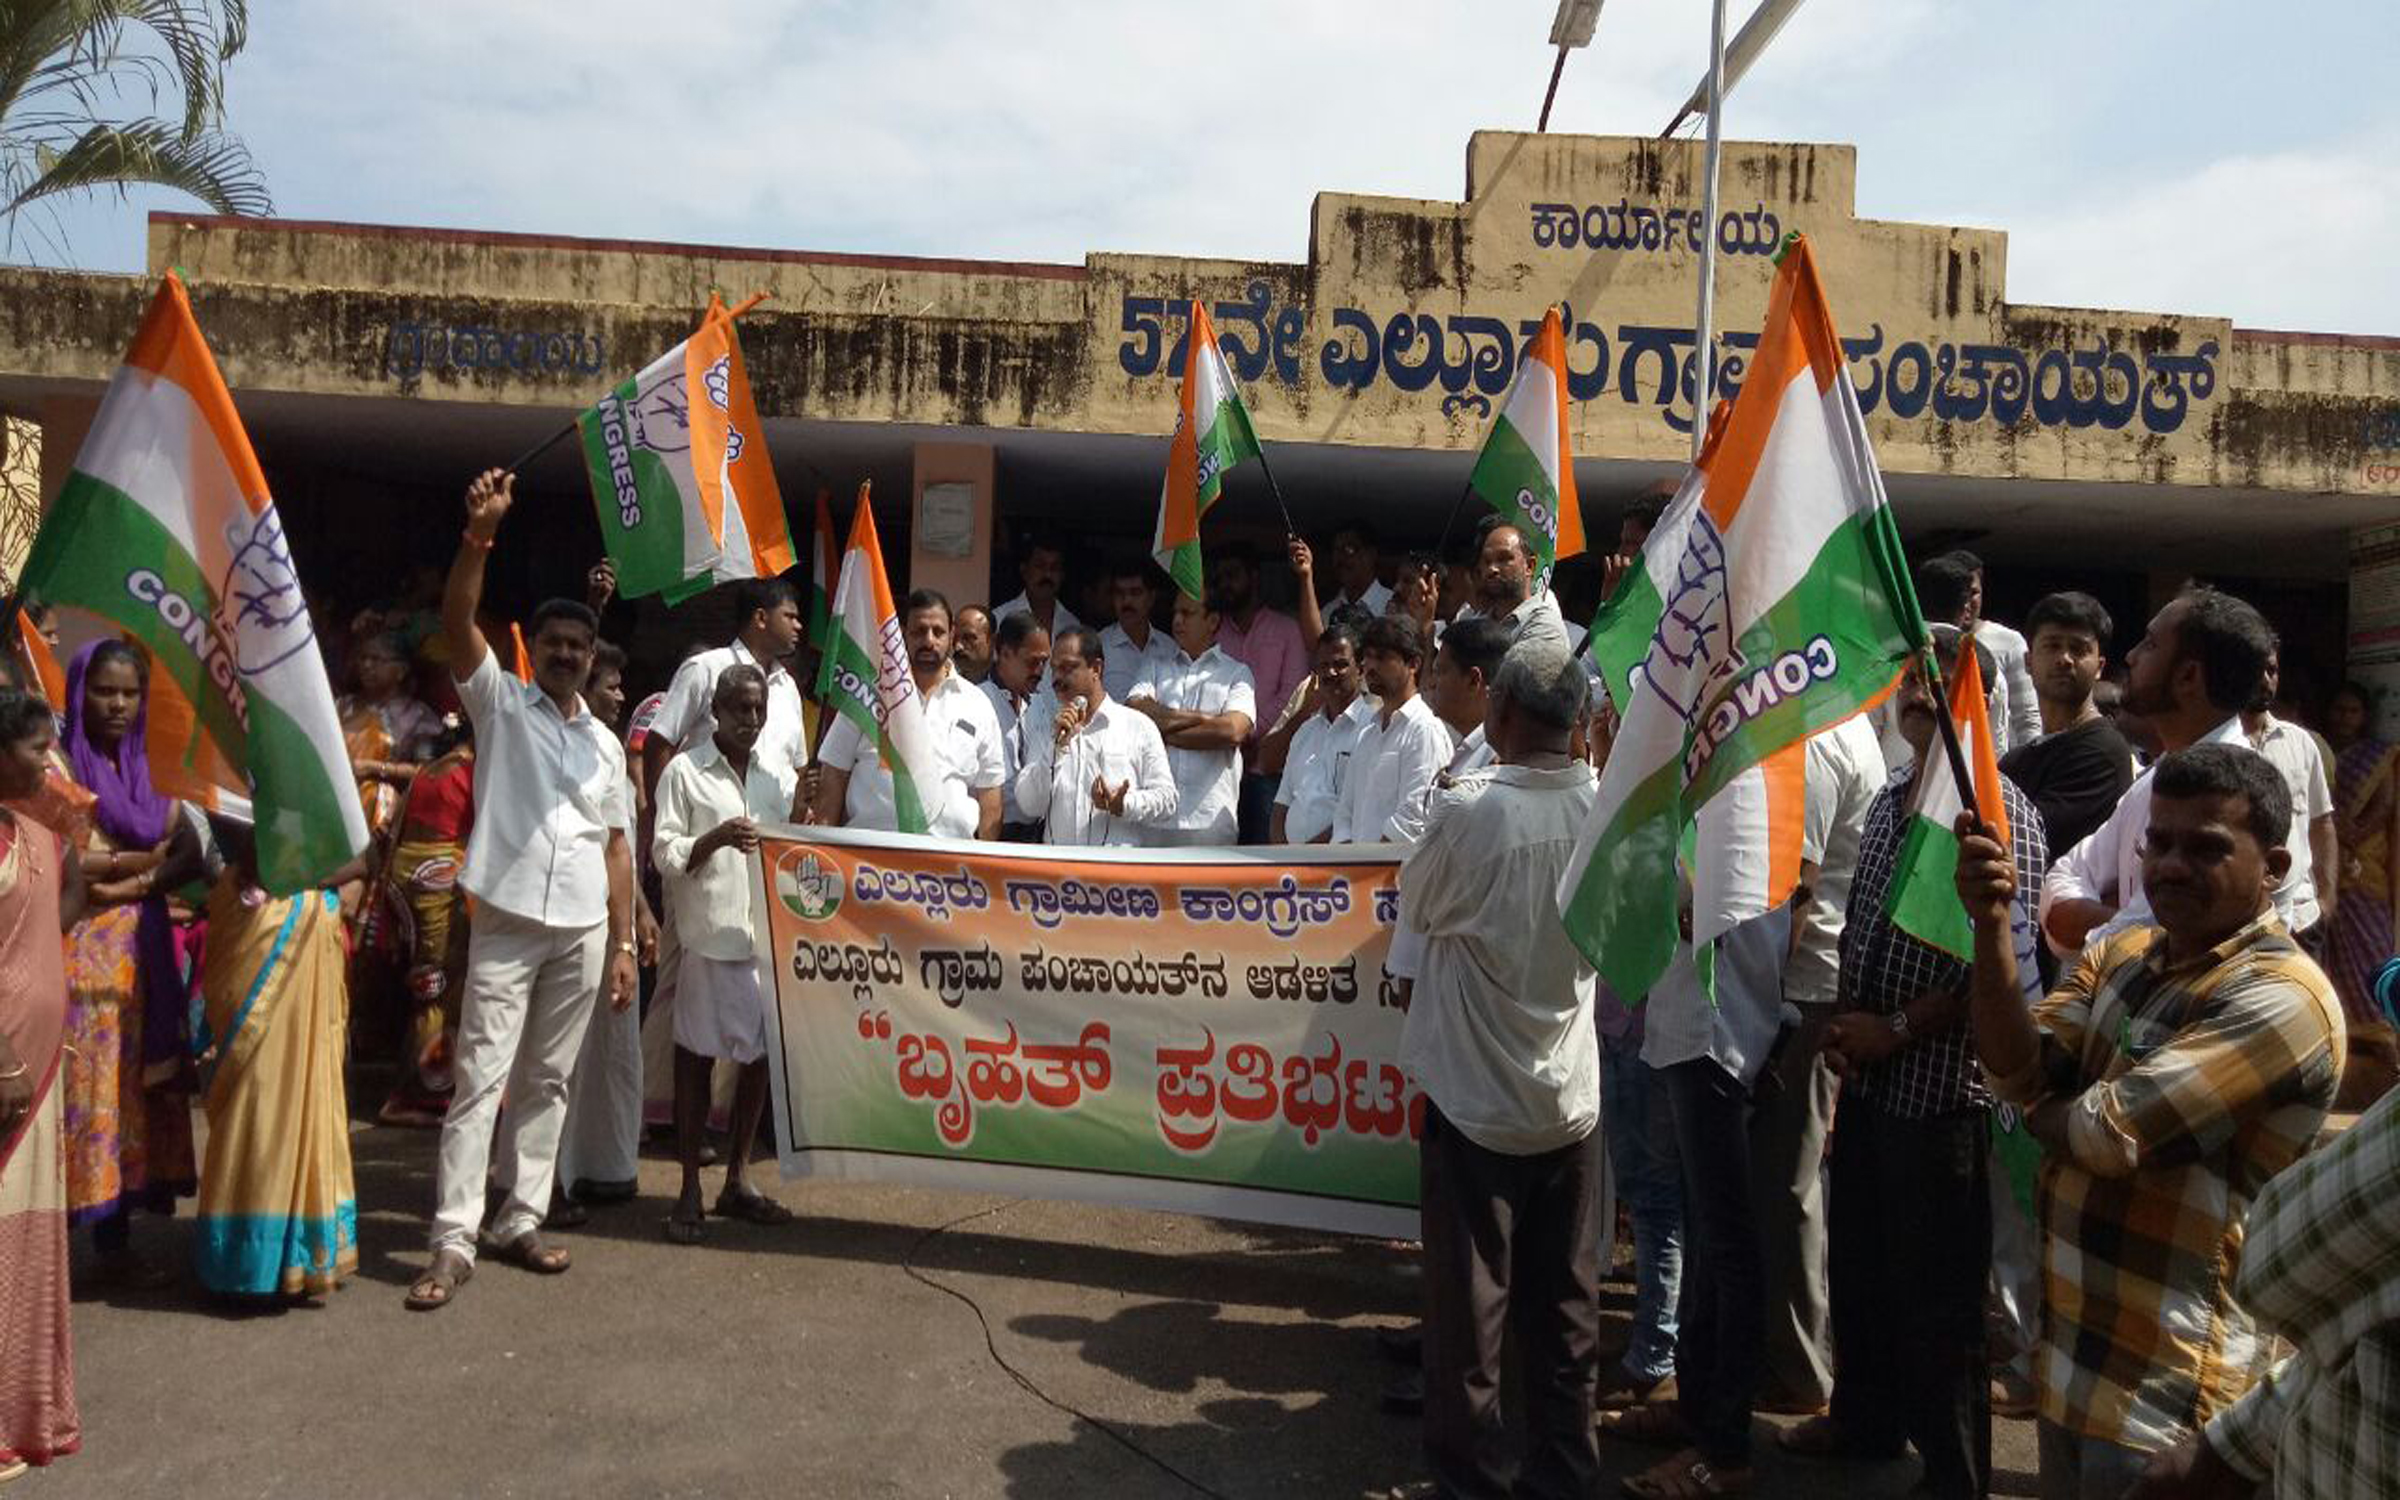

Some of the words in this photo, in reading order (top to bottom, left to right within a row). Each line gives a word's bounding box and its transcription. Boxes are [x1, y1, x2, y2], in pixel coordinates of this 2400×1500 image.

[1119, 280, 1305, 386] 57ನೇ
[598, 392, 641, 529] NGRESS
[854, 864, 988, 920] ಎಲ್ಲೂರು
[1006, 877, 1160, 928] ಗ್ರಾಮೀಣ
[1180, 876, 1351, 937] ಕಾಂಗ್ರೆಸ್
[793, 936, 904, 1001] ಎಲ್ಲೂರು
[920, 938, 1003, 1009] ಗ್ರಾಮ
[1246, 953, 1359, 1004] ಆಡಳಿತ
